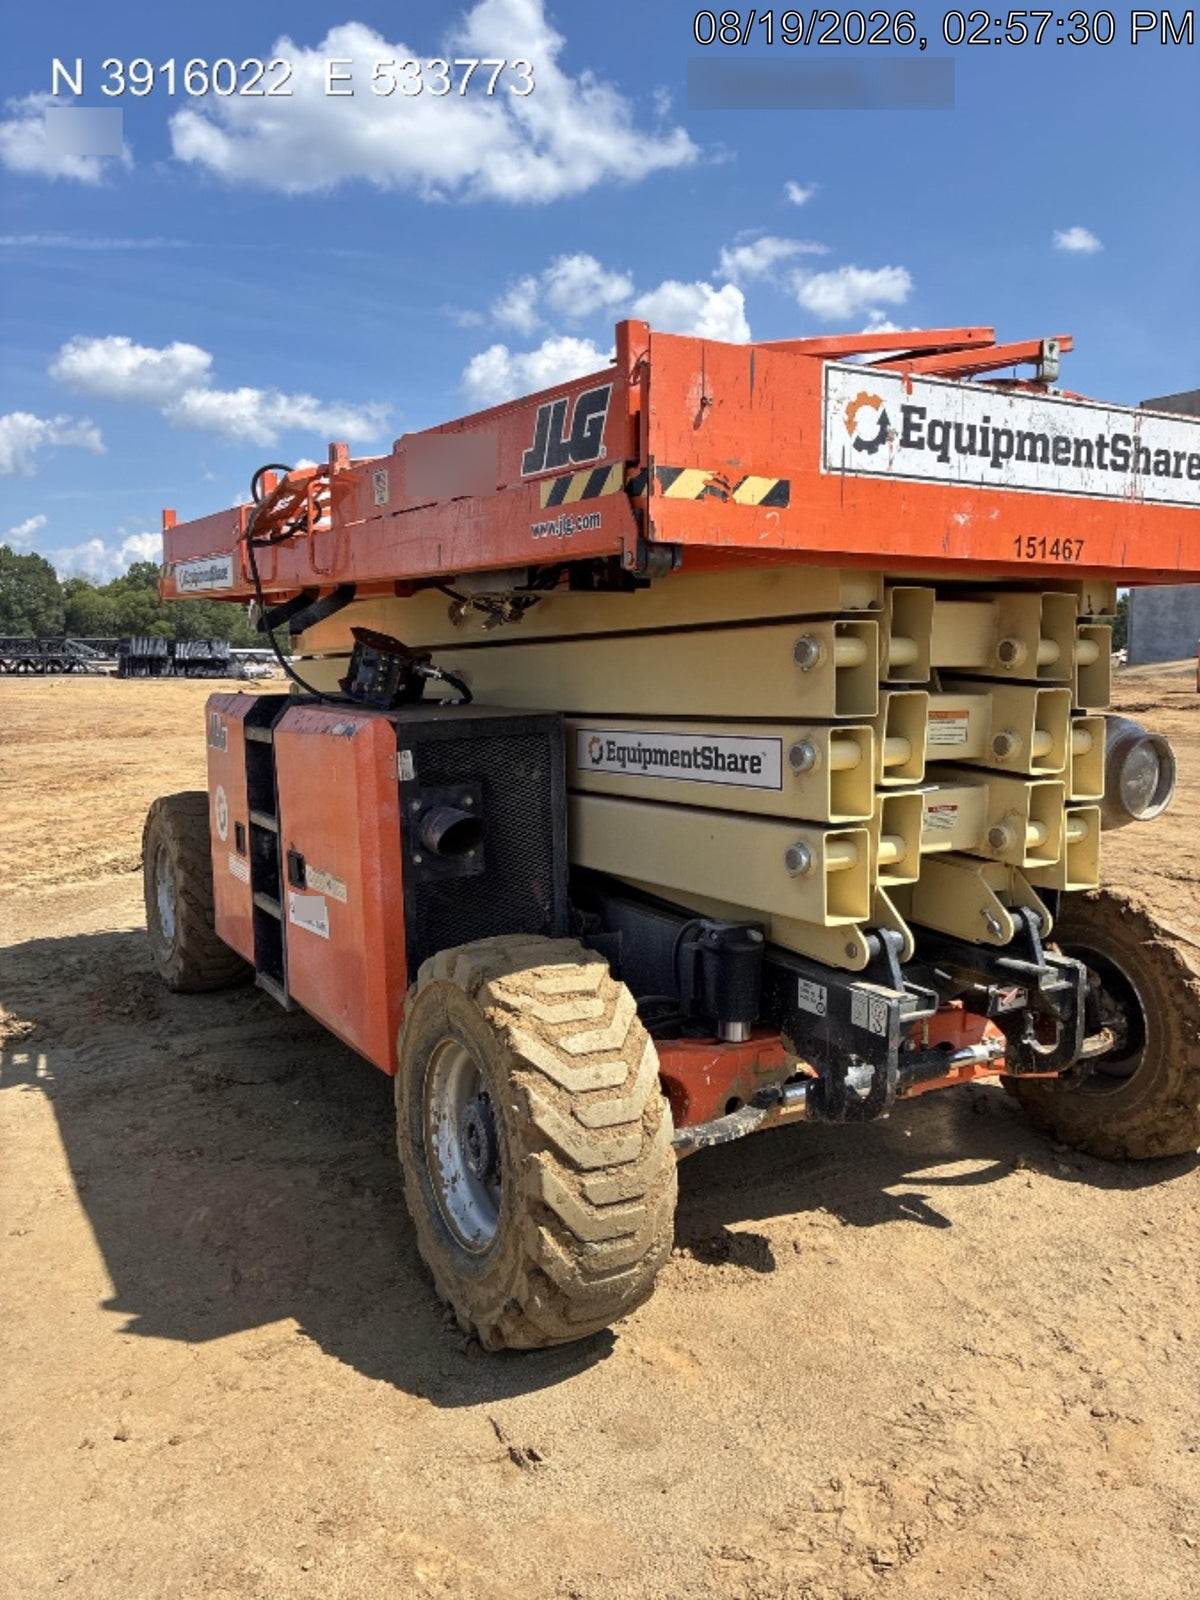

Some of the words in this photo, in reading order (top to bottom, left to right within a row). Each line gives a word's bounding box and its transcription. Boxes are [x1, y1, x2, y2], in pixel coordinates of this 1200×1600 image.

[521, 383, 614, 478] JLG
[531, 512, 602, 540] www.jlg.com
[1014, 535, 1085, 560] 151467
[606, 740, 762, 774] EquipmentShare
